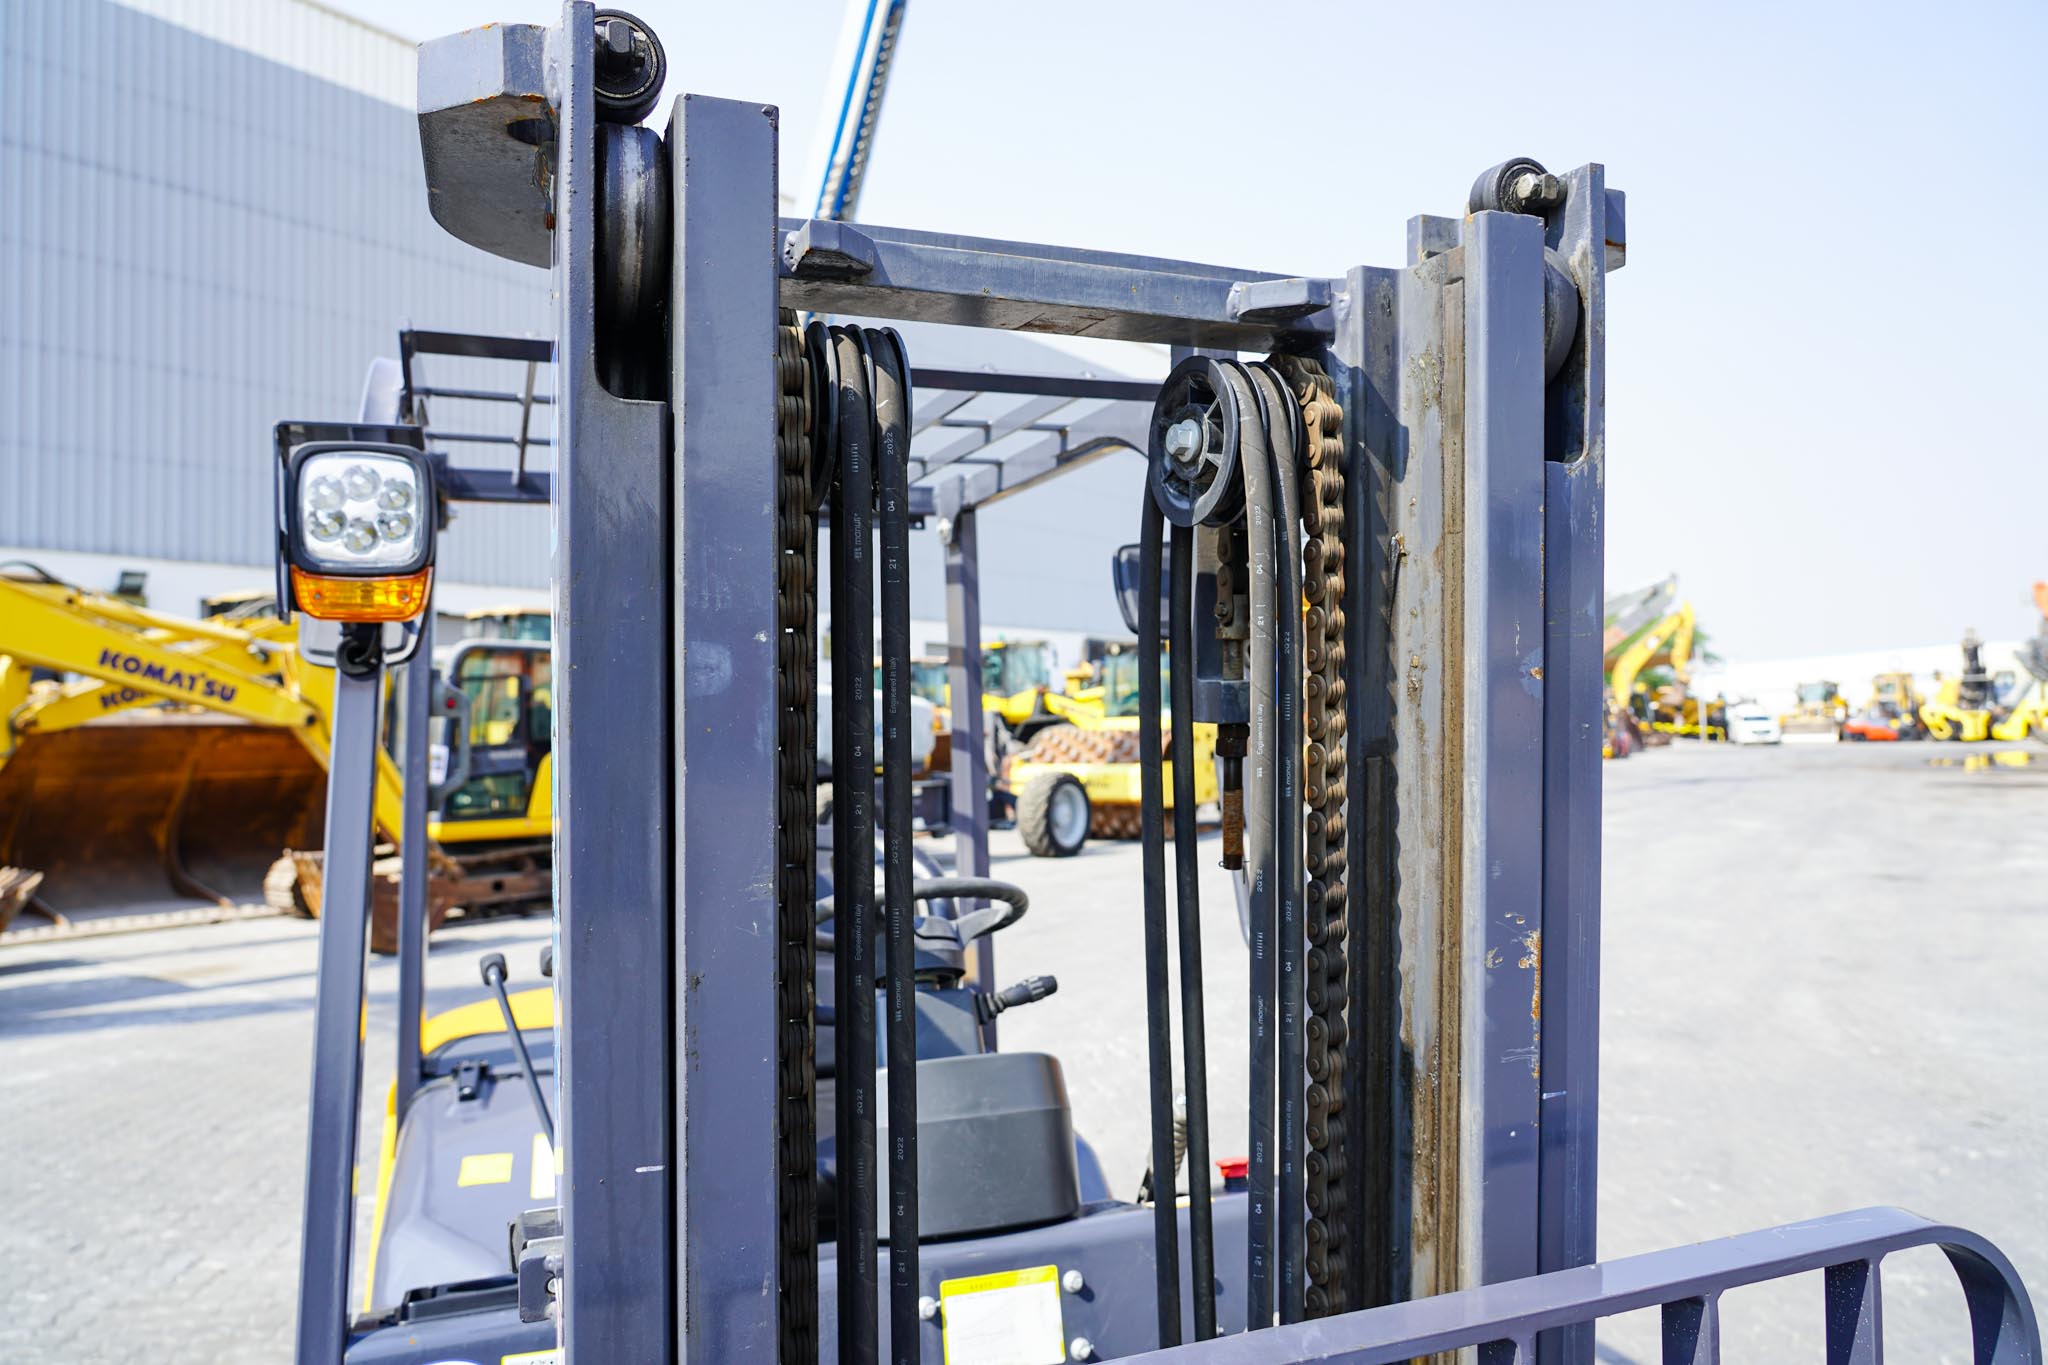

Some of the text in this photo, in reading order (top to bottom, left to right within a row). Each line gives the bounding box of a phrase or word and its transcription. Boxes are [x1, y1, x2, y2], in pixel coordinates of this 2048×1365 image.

[886, 432, 894, 455] 2022
[887, 500, 895, 512] 04
[1254, 504, 1262, 526] 2022
[99, 649, 237, 702] KOMATSU
[854, 676, 862, 701] 2022
[854, 745, 862, 757] 04
[1285, 962, 1292, 972] 04
[897, 1205, 904, 1216] 04
[1255, 1203, 1262, 1214] 04
